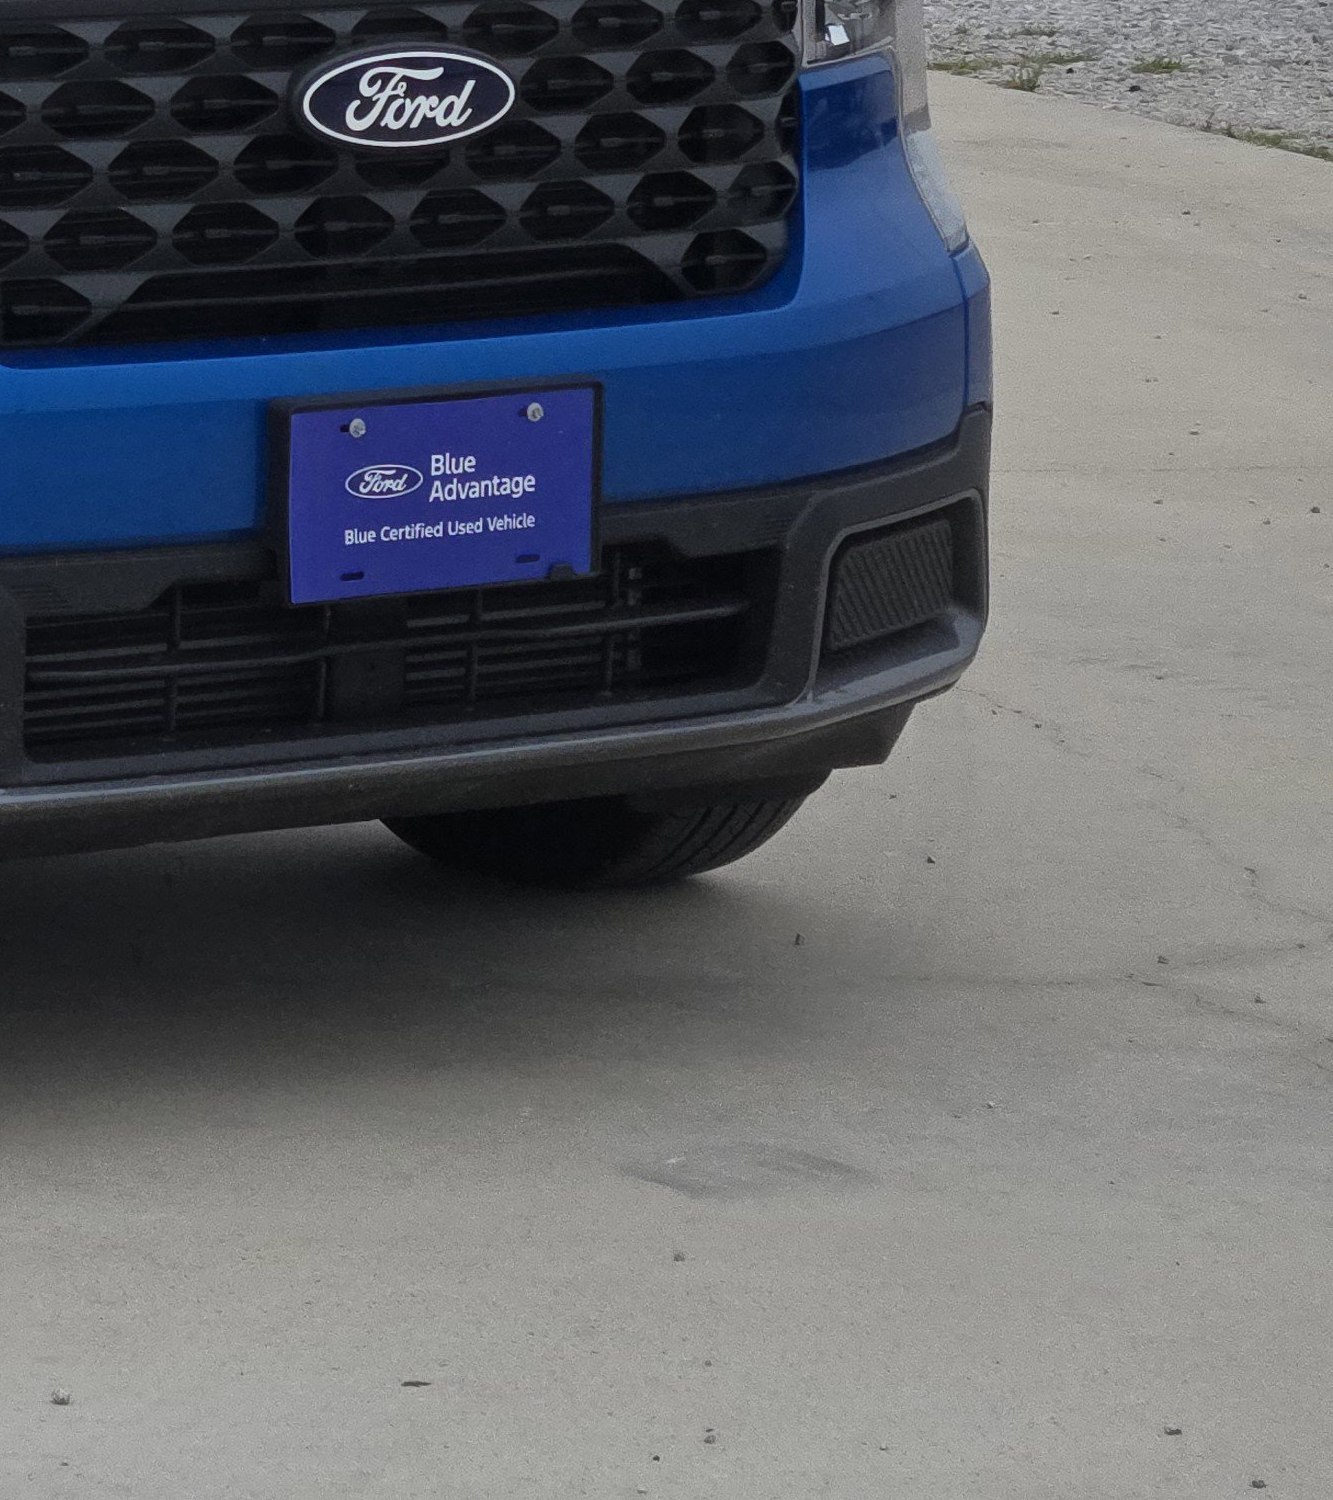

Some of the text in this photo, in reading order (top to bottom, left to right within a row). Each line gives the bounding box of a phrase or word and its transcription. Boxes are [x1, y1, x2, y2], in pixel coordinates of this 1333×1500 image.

[431, 453, 476, 476] Blue
[428, 473, 536, 502] Advantage
[344, 513, 536, 545] Blue Certified Used Vehicle
